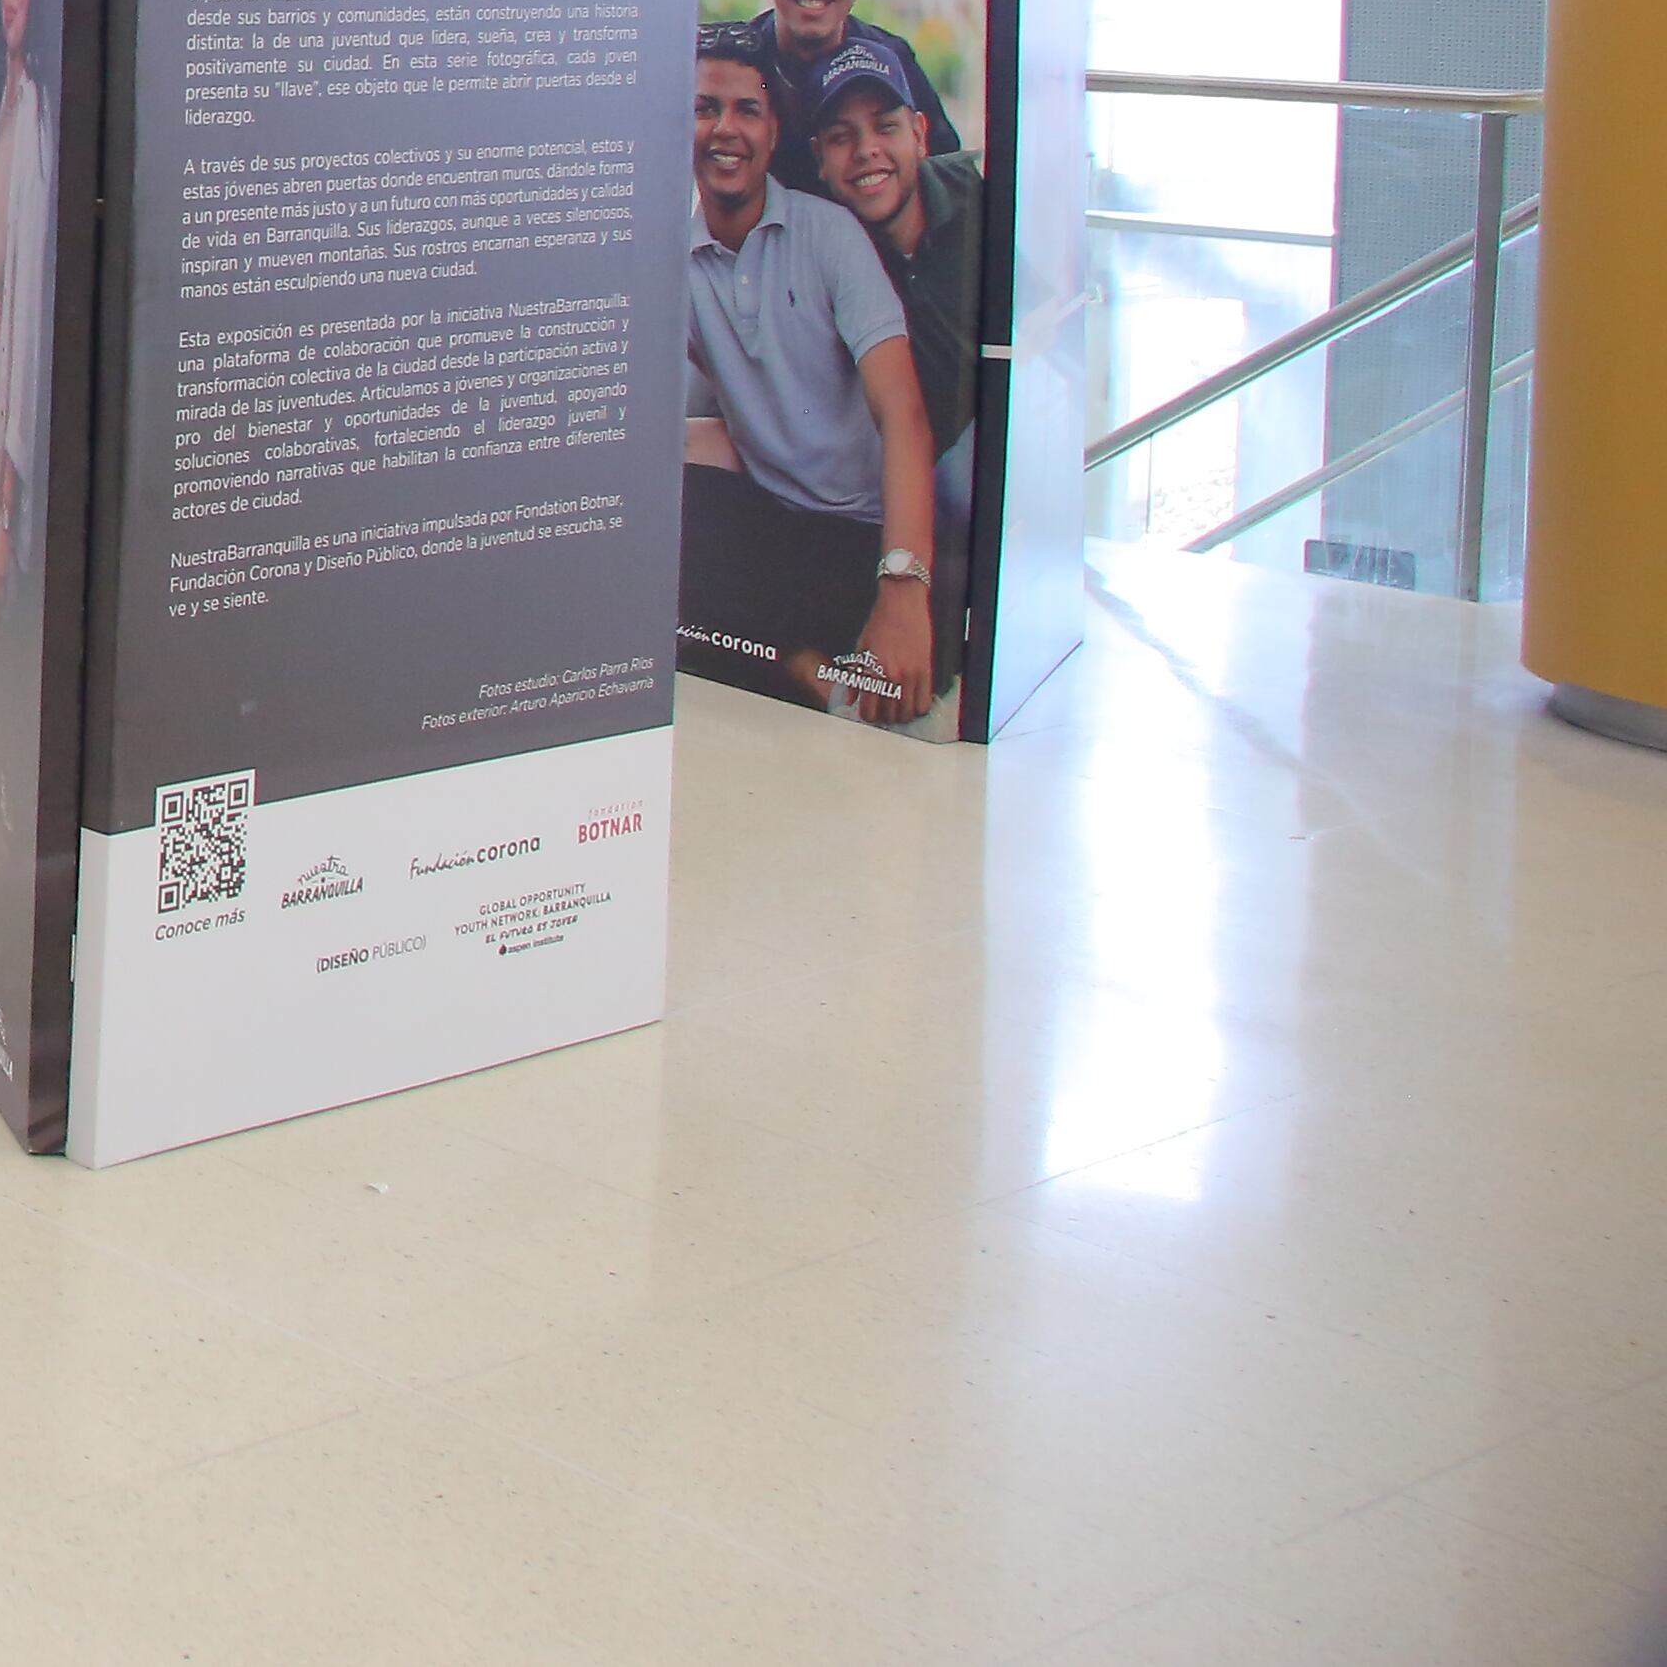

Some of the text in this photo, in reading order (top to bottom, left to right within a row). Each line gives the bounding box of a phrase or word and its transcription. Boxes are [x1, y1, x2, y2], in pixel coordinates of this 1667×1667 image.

[171, 536, 310, 567] NuestraBarranquilla
[314, 535, 329, 548] es
[333, 531, 357, 545] una
[361, 523, 419, 541] iniciativa
[422, 511, 487, 533] impulsada
[490, 510, 512, 525] por
[515, 500, 577, 527] Fondation
[170, 569, 245, 592] Fundación
[249, 563, 300, 580] Corona
[304, 561, 313, 576] y
[317, 552, 362, 571] Diseño
[366, 545, 418, 563] Público,
[421, 537, 463, 555] donde
[467, 535, 477, 549] la
[479, 526, 535, 550] juventud
[537, 527, 552, 539] se
[609, 517, 622, 528] se
[169, 591, 269, 617] ve y se siente.
[710, 629, 778, 661] corona
[479, 683, 513, 698] Fotos
[514, 674, 560, 692] estudio:
[562, 667, 597, 683] Carlos
[599, 663, 628, 677] Parra
[817, 663, 903, 700] BARRANQUILLA
[421, 714, 456, 729] Fotos
[509, 698, 547, 713] Arturo
[549, 689, 596, 707] Aparicio
[578, 813, 643, 844] BOTNAR
[297, 854, 353, 886] nuestra
[409, 836, 541, 879] Fundación corona
[281, 877, 364, 909] BARRANQUILLA
[479, 884, 585, 915] GLOBAL OPPORTUNITY
[155, 908, 245, 941] Conoce más
[455, 920, 488, 935] YOUTH
[543, 893, 611, 915] BARRANQUILLA
[317, 936, 426, 973] (DISEÑO PÚBLICO)
